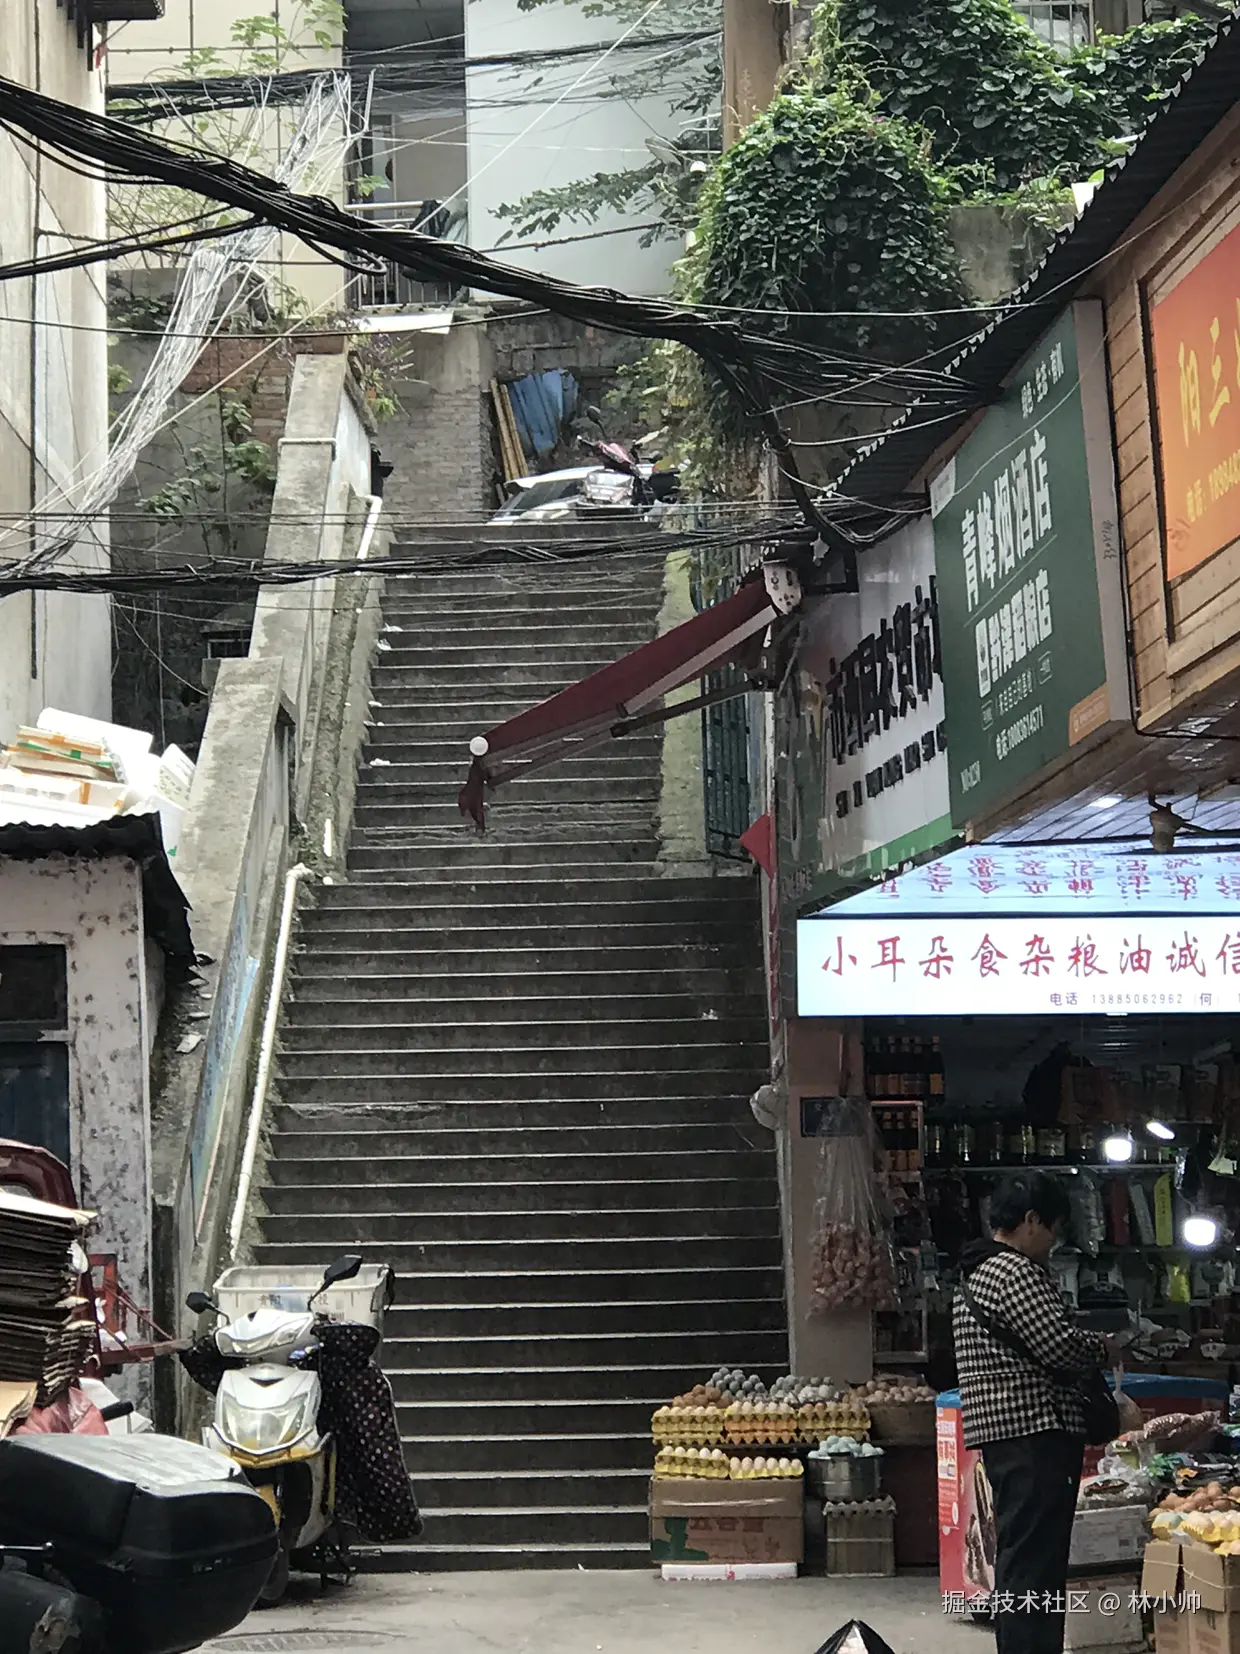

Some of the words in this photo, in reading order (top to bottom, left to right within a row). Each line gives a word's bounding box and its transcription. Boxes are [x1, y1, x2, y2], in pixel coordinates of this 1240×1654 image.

[961, 428, 1053, 613] 青峰烟酒店
[821, 930, 1240, 983] 小耳朵食杂粮油诚信
[1050, 992, 1078, 1006] 电话
[1092, 993, 1183, 1005] 13885062962
